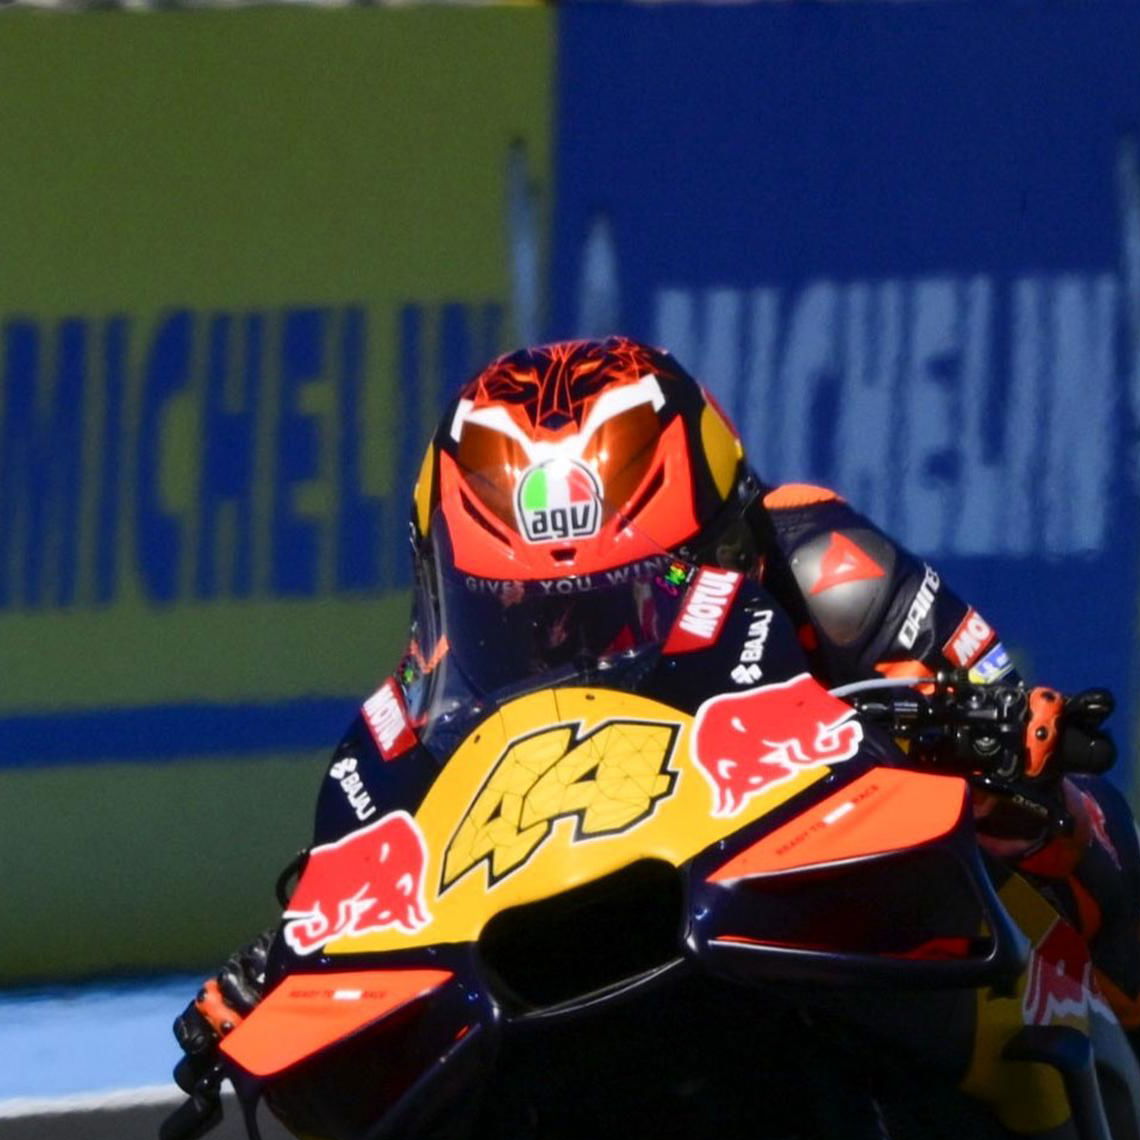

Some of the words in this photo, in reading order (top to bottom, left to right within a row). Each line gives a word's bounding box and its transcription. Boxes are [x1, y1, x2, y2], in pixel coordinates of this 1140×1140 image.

[531, 504, 590, 538] agv
[540, 576, 592, 594] YOU
[678, 569, 740, 640] MOTUL
[740, 609, 774, 662] BAJAJ
[363, 684, 406, 752] MOTUL
[340, 771, 377, 821] BAJAJ
[436, 718, 682, 898] 44
